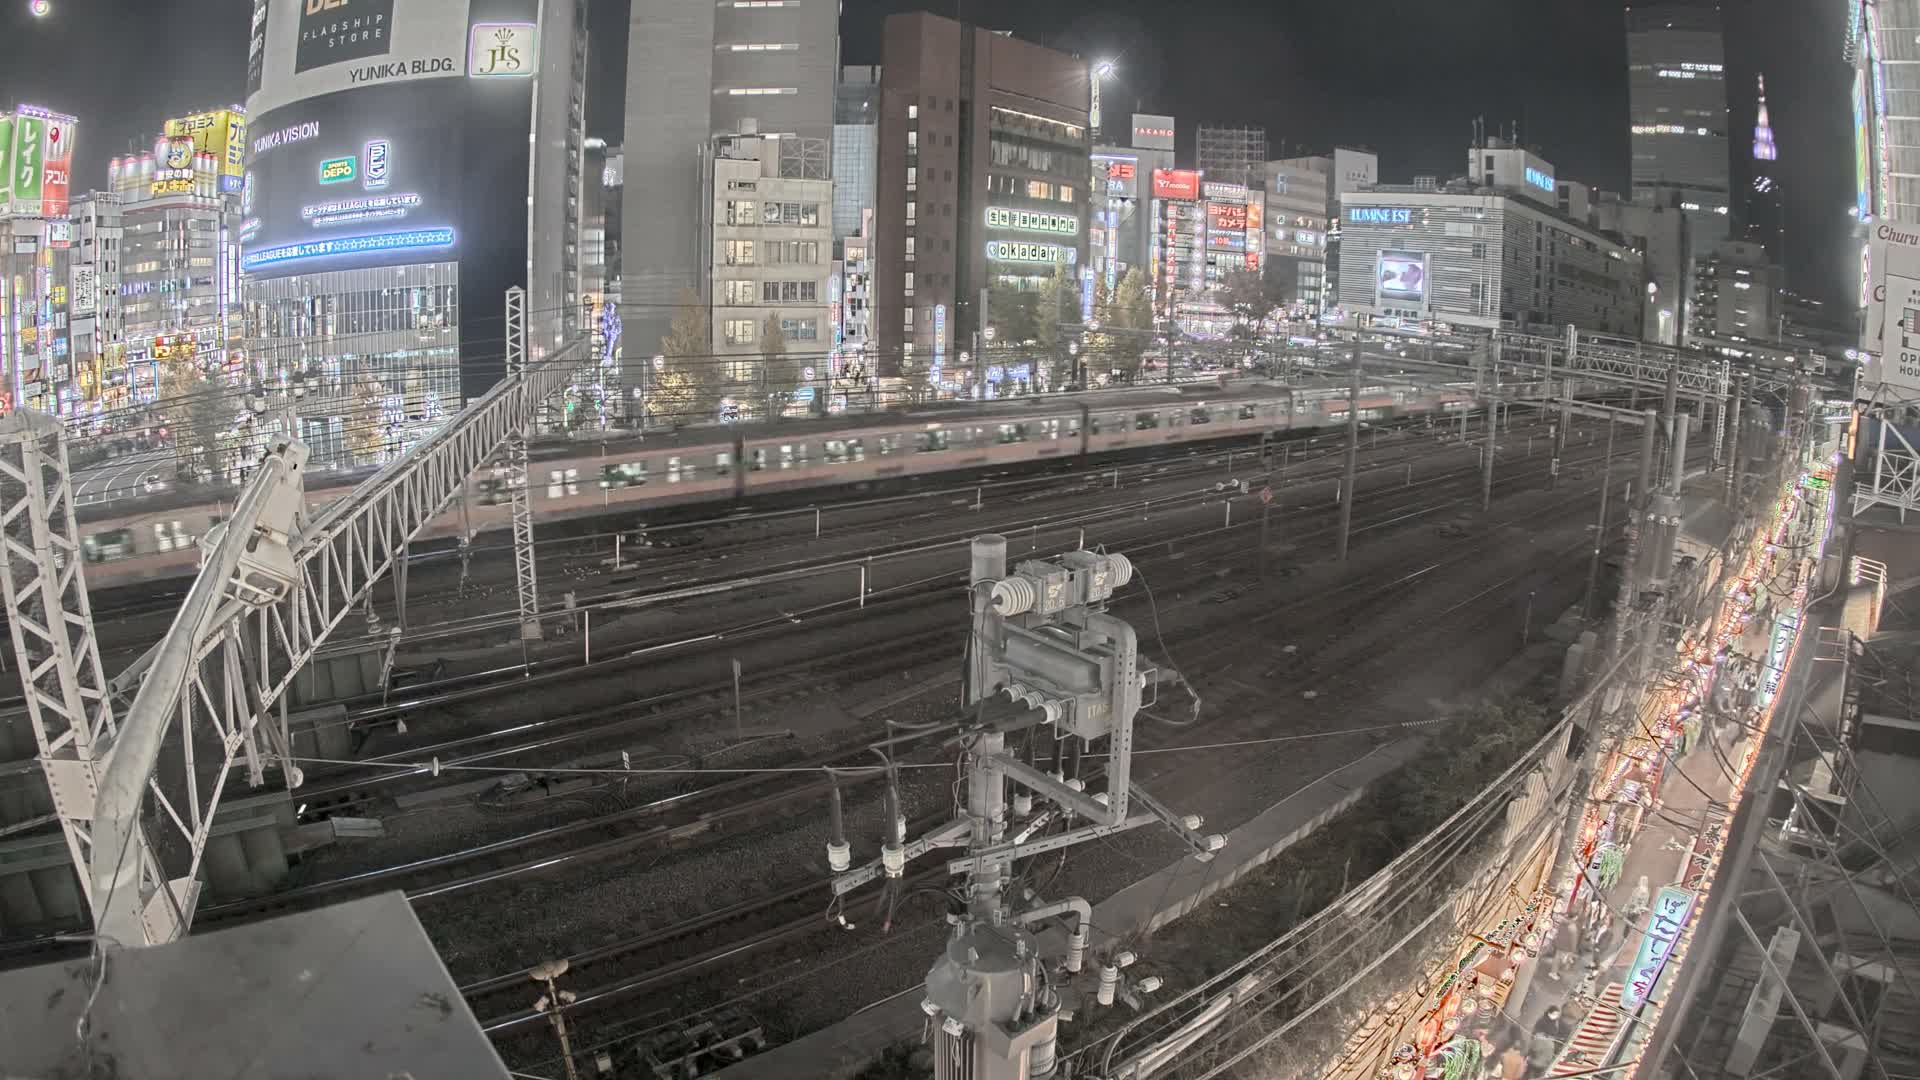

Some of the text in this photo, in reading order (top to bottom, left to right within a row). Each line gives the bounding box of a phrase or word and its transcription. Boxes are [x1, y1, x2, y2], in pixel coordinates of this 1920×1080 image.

[303, 14, 383, 40] FLAGSHIP
[328, 28, 382, 48] STORE
[349, 57, 456, 83] YUNIKA BLDG.
[254, 120, 319, 153] YUNIKA VISION
[1134, 127, 1174, 137] TAKANO
[45, 169, 68, 185] アコム
[323, 165, 353, 178] DEPO
[1209, 205, 1246, 217] ヨドバシ
[1351, 208, 1411, 223] LUMINE EST
[1217, 218, 1246, 229] カメラ
[1877, 224, 1919, 246] Churu
